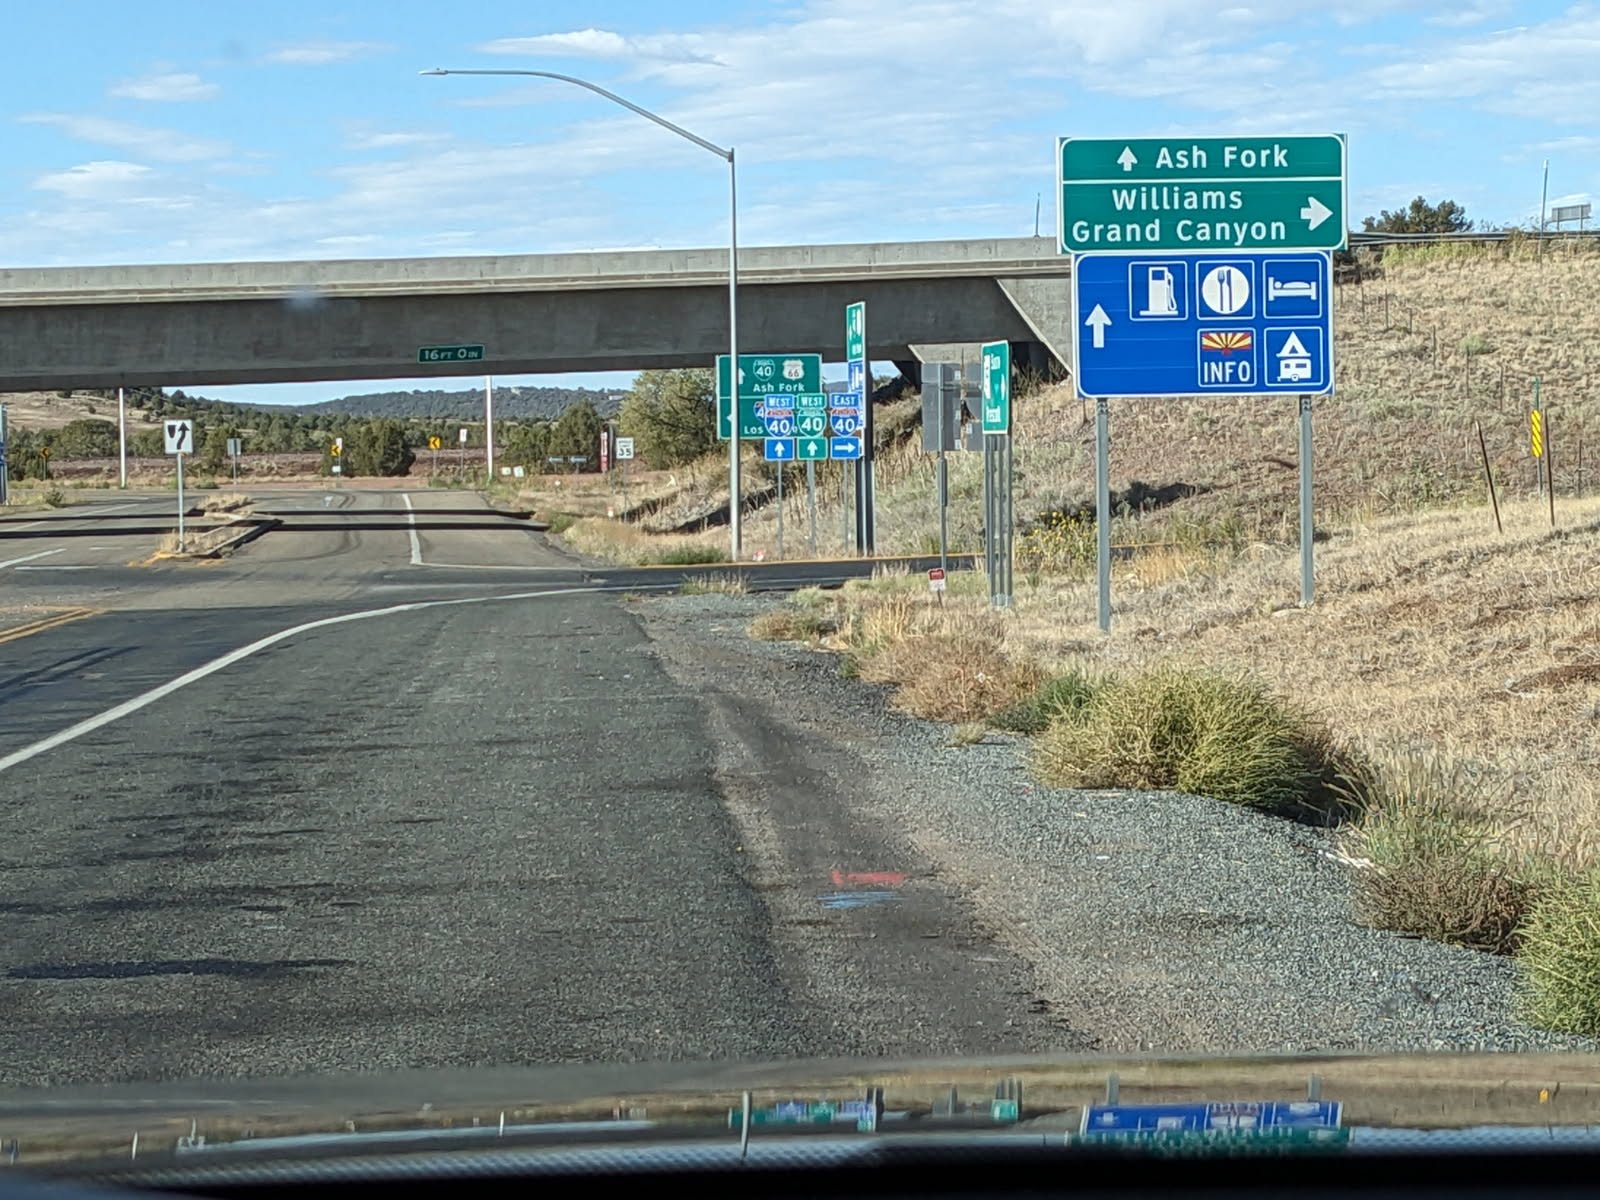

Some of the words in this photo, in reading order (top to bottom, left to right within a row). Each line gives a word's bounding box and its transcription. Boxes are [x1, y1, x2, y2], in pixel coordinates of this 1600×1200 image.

[1155, 145, 1207, 169] Ash
[1224, 143, 1289, 168] Fork
[1111, 186, 1244, 210] Williams
[1072, 219, 1161, 243] Grand
[1176, 218, 1287, 246] Canyon
[756, 366, 772, 377] 40
[787, 369, 800, 378] 66
[1203, 361, 1251, 383] INFO
[753, 383, 774, 392] Ash
[779, 383, 805, 392] Fork
[768, 397, 790, 406] WEST
[801, 396, 823, 406] WEST
[834, 396, 855, 405] EAST
[769, 420, 790, 434] 40
[801, 417, 823, 432] 40
[834, 418, 855, 432] 40
